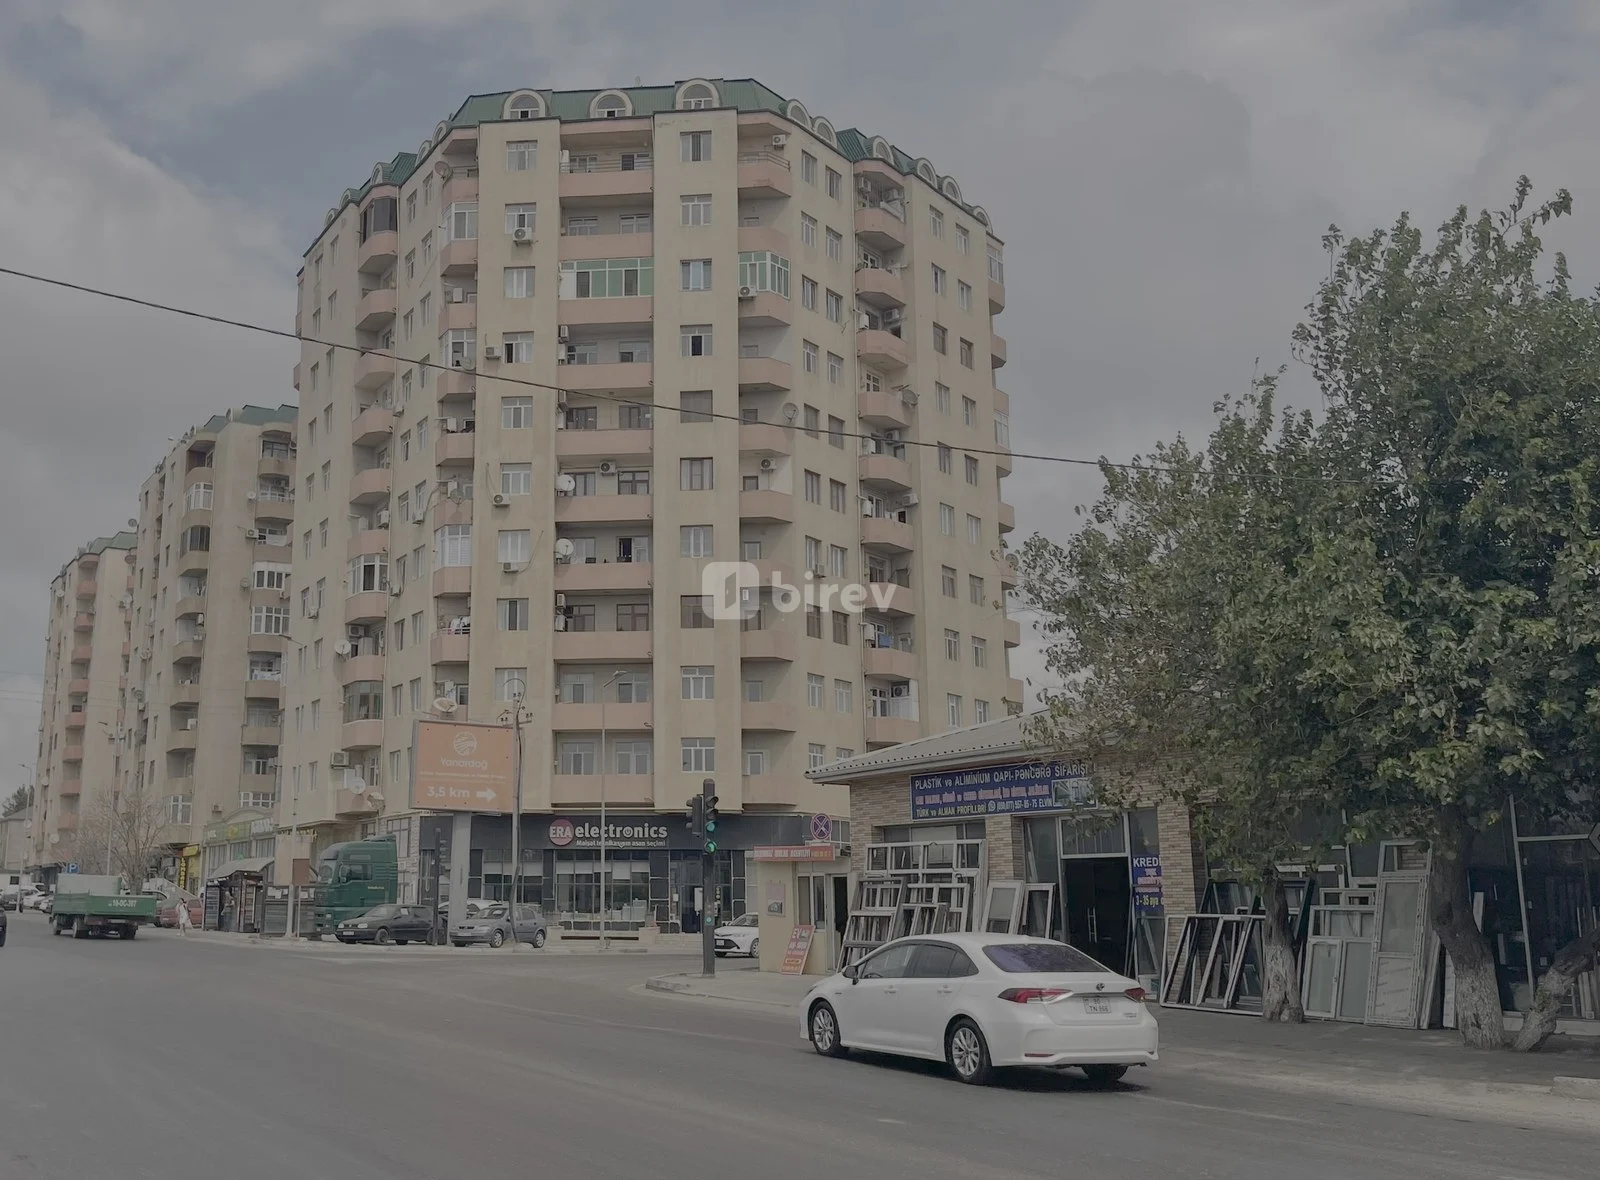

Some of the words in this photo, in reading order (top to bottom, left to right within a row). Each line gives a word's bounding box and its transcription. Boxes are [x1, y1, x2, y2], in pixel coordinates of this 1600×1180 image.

[427, 786, 446, 798] 3,5
[449, 787, 470, 798] km
[549, 826, 573, 838] ERA
[574, 822, 668, 838] electronics
[69, 863, 77, 873] P
